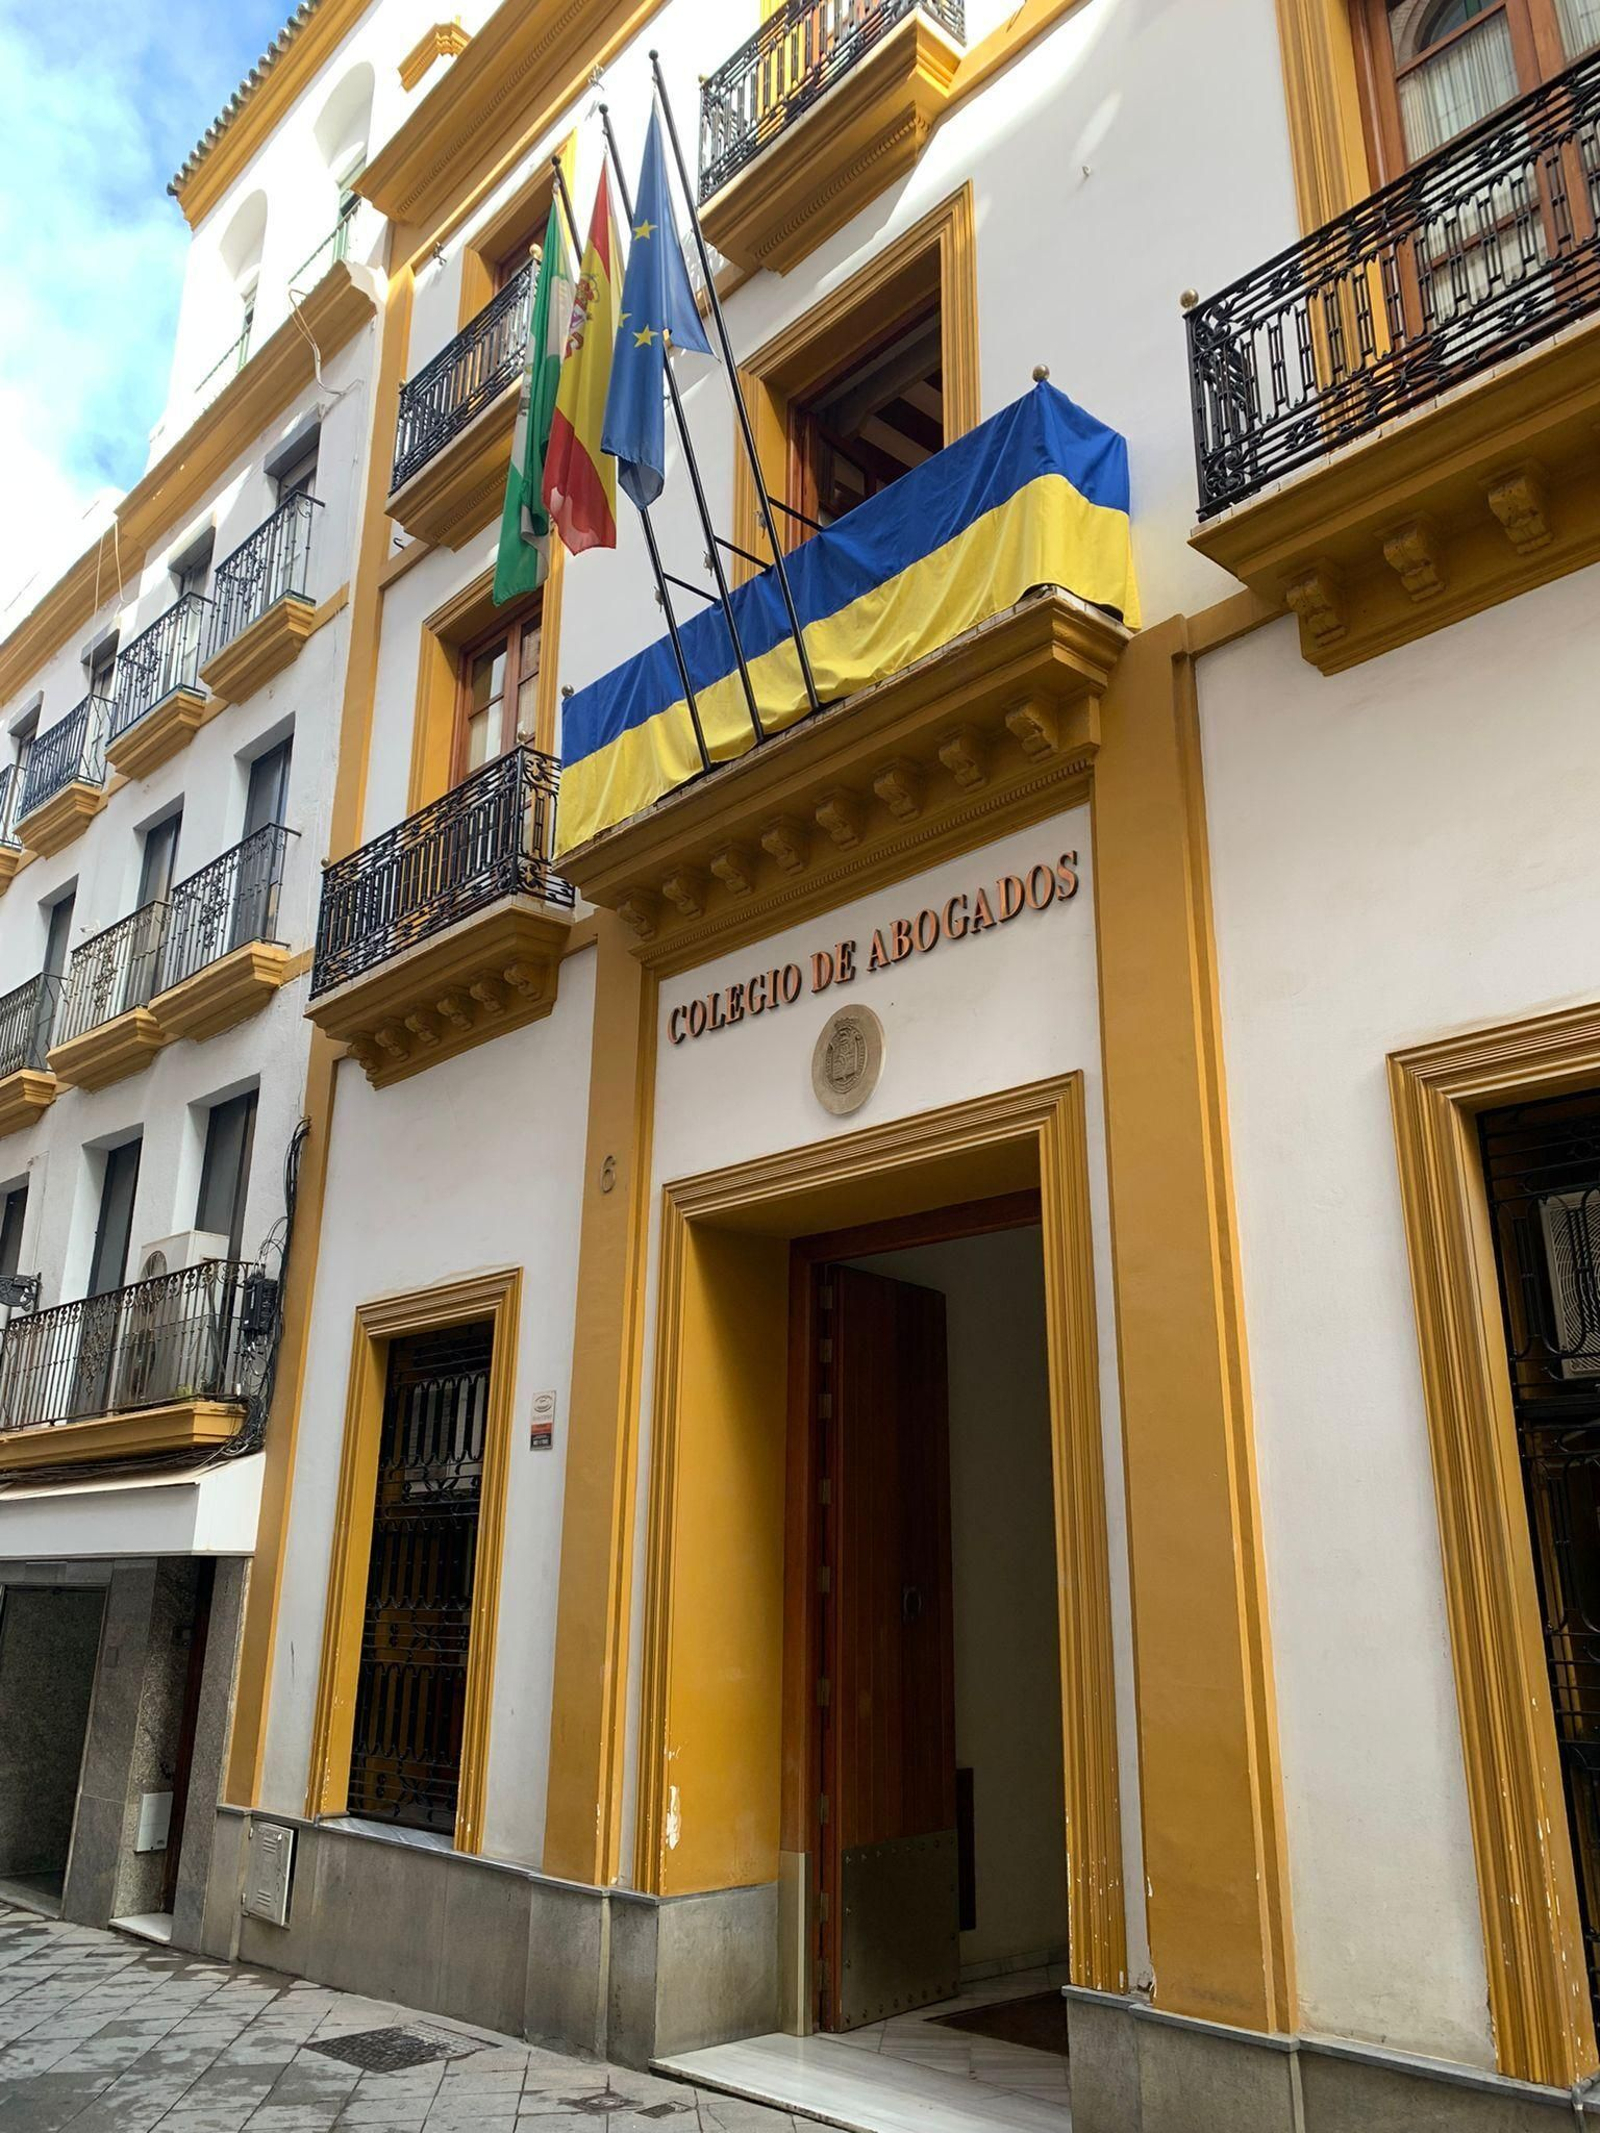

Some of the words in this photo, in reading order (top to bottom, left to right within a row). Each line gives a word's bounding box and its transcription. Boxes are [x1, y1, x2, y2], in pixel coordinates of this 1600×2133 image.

[667, 963, 802, 1045] COLEGIO
[810, 940, 857, 993] DE
[866, 850, 1079, 972] ABOGADOS
[601, 1154, 616, 1194] 6
